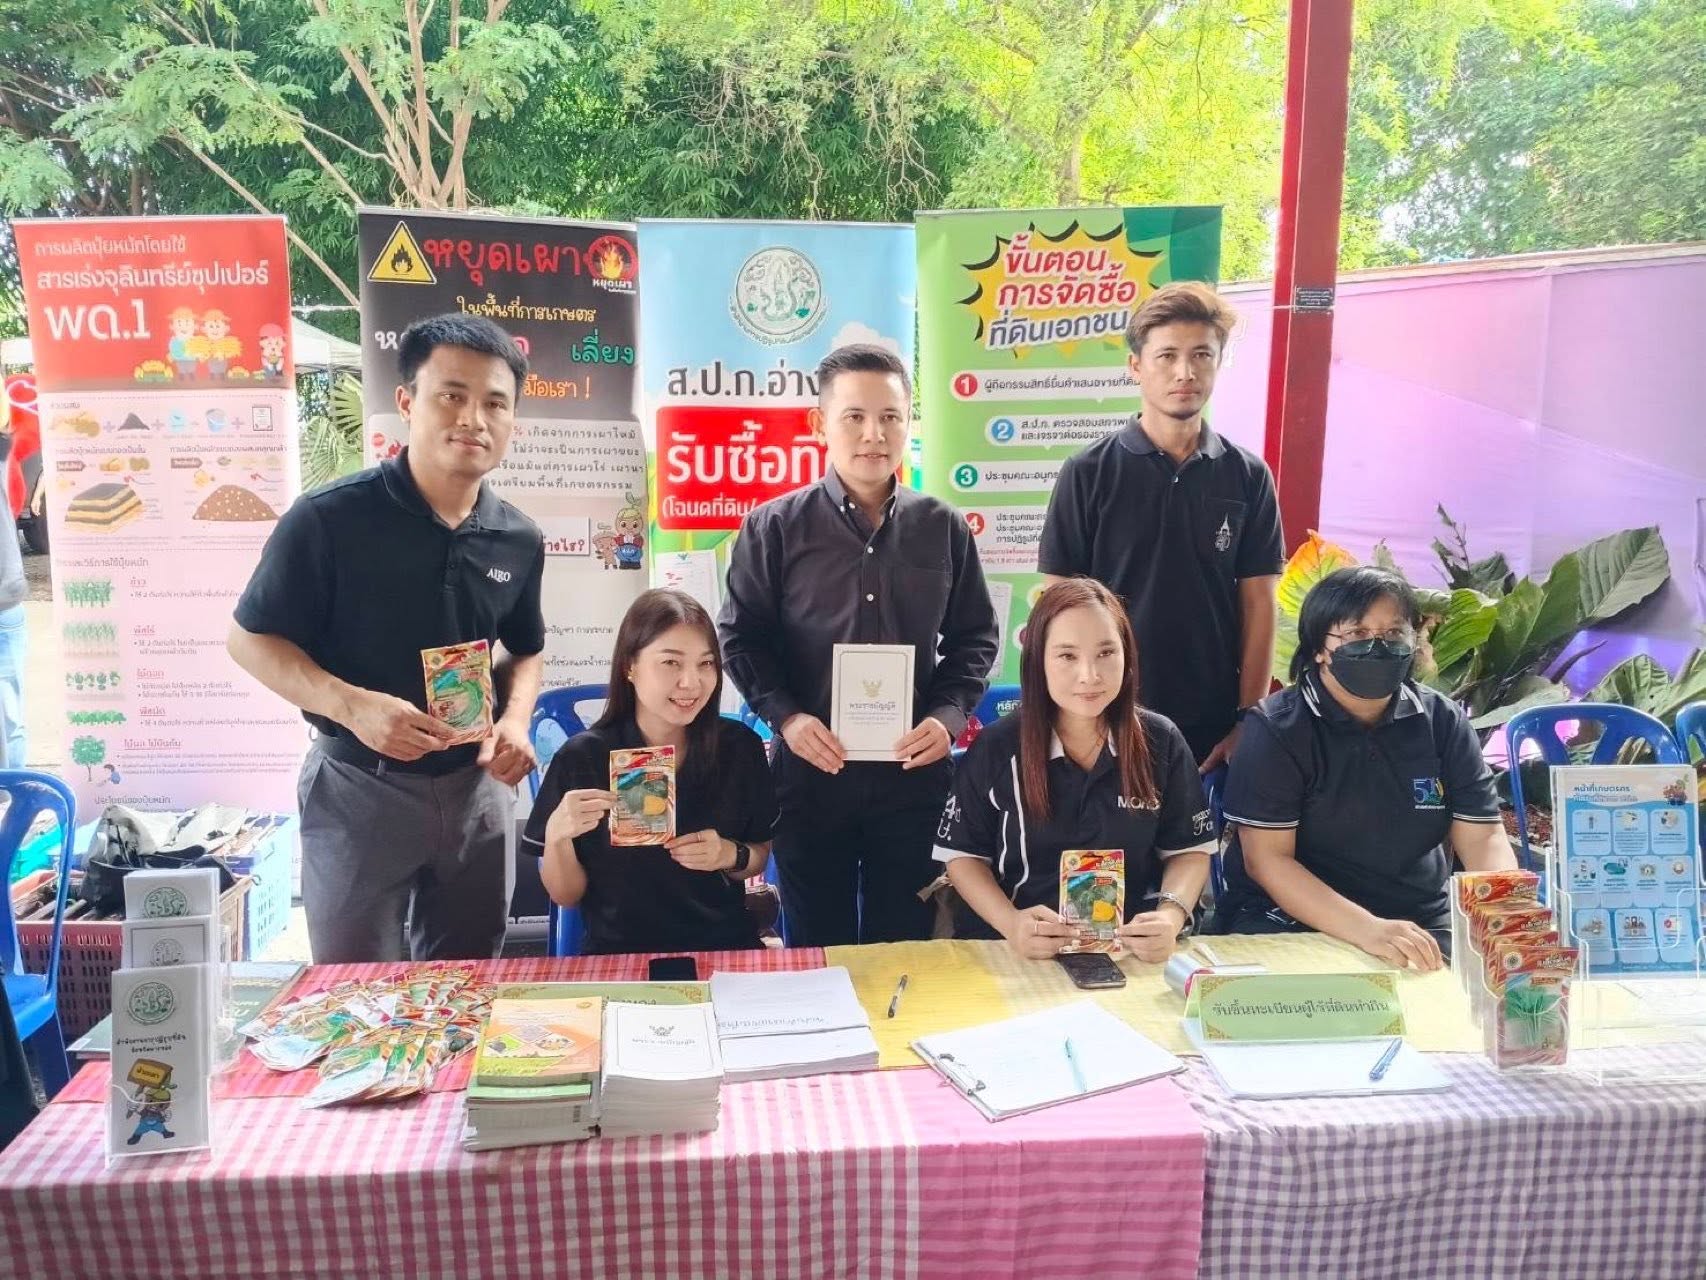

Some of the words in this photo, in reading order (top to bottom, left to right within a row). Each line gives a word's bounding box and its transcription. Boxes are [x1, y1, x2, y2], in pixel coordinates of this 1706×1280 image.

[35, 235, 186, 258] การผลิตปุ๋ยหมักโดยใช้
[423, 239, 580, 287] หยุดเผา
[1006, 234, 1107, 275] ขั้นตอน
[36, 259, 270, 297] สารเร่งจุลินทรีย์ซุปเปอร์
[998, 262, 1137, 307] การจัดซื้อ
[43, 298, 151, 341] พด.1
[456, 294, 597, 322] ในพื้นที่การเกษตร
[988, 308, 1128, 346] ที่ดินเอกชน
[571, 328, 635, 366] เลี่ยง
[994, 422, 1010, 440] 2
[1053, 417, 1128, 427] ตรวจสอบสภาพ
[487, 473, 633, 490] รเตรียมพื้นที่เกษตรกรรม
[960, 468, 973, 488] 3
